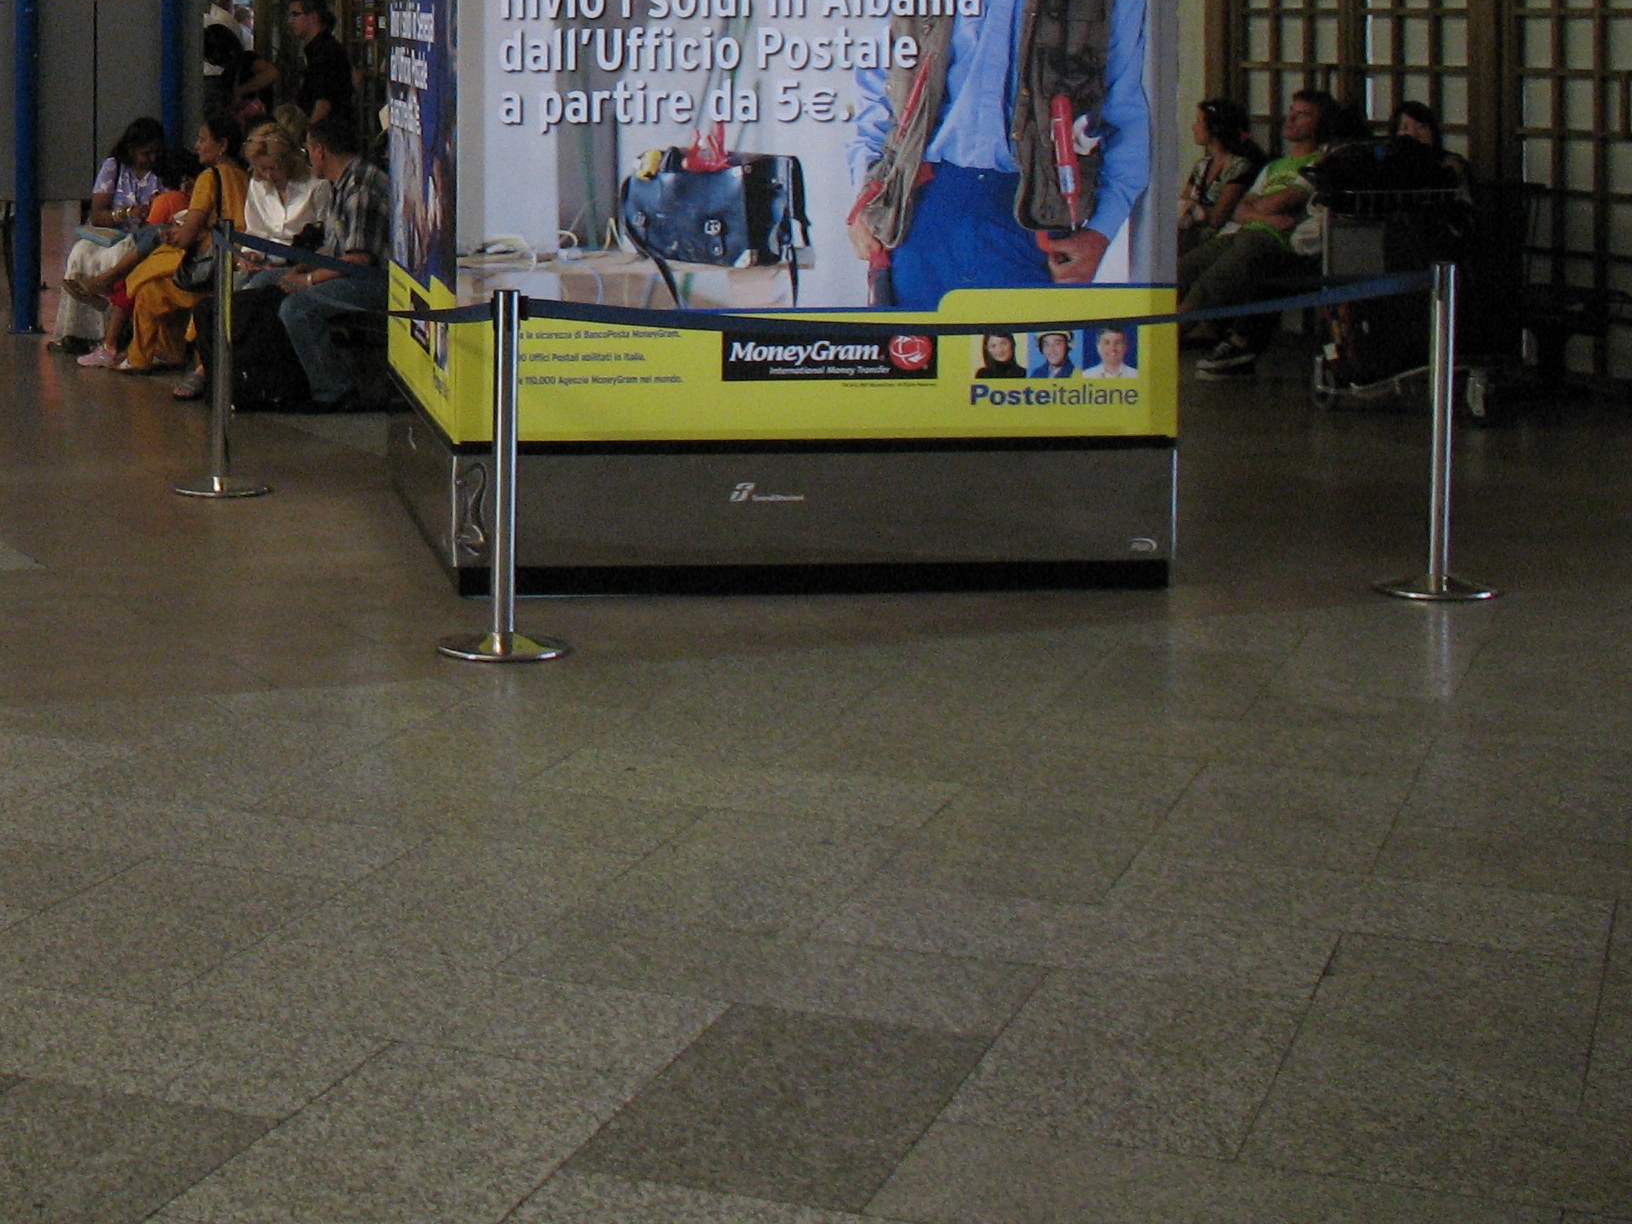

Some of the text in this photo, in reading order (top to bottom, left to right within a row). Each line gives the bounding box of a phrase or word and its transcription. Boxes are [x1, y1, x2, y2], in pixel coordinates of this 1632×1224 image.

[499, 23, 920, 74] dall'Ufficio Postale
[499, 87, 525, 126] a
[538, 79, 696, 133] partire
[712, 79, 761, 126] da
[535, 331, 572, 339] sicurezza
[574, 330, 582, 339] di
[583, 330, 630, 339] BancoPosta
[529, 353, 550, 362] Uffici
[552, 353, 580, 362] Postali
[728, 341, 880, 366] MoneyGram
[769, 365, 891, 376] International Money Transfer
[558, 376, 589, 387] Agenzie
[591, 376, 638, 386] MoneyGram
[970, 383, 1139, 406] Posteitaliane
